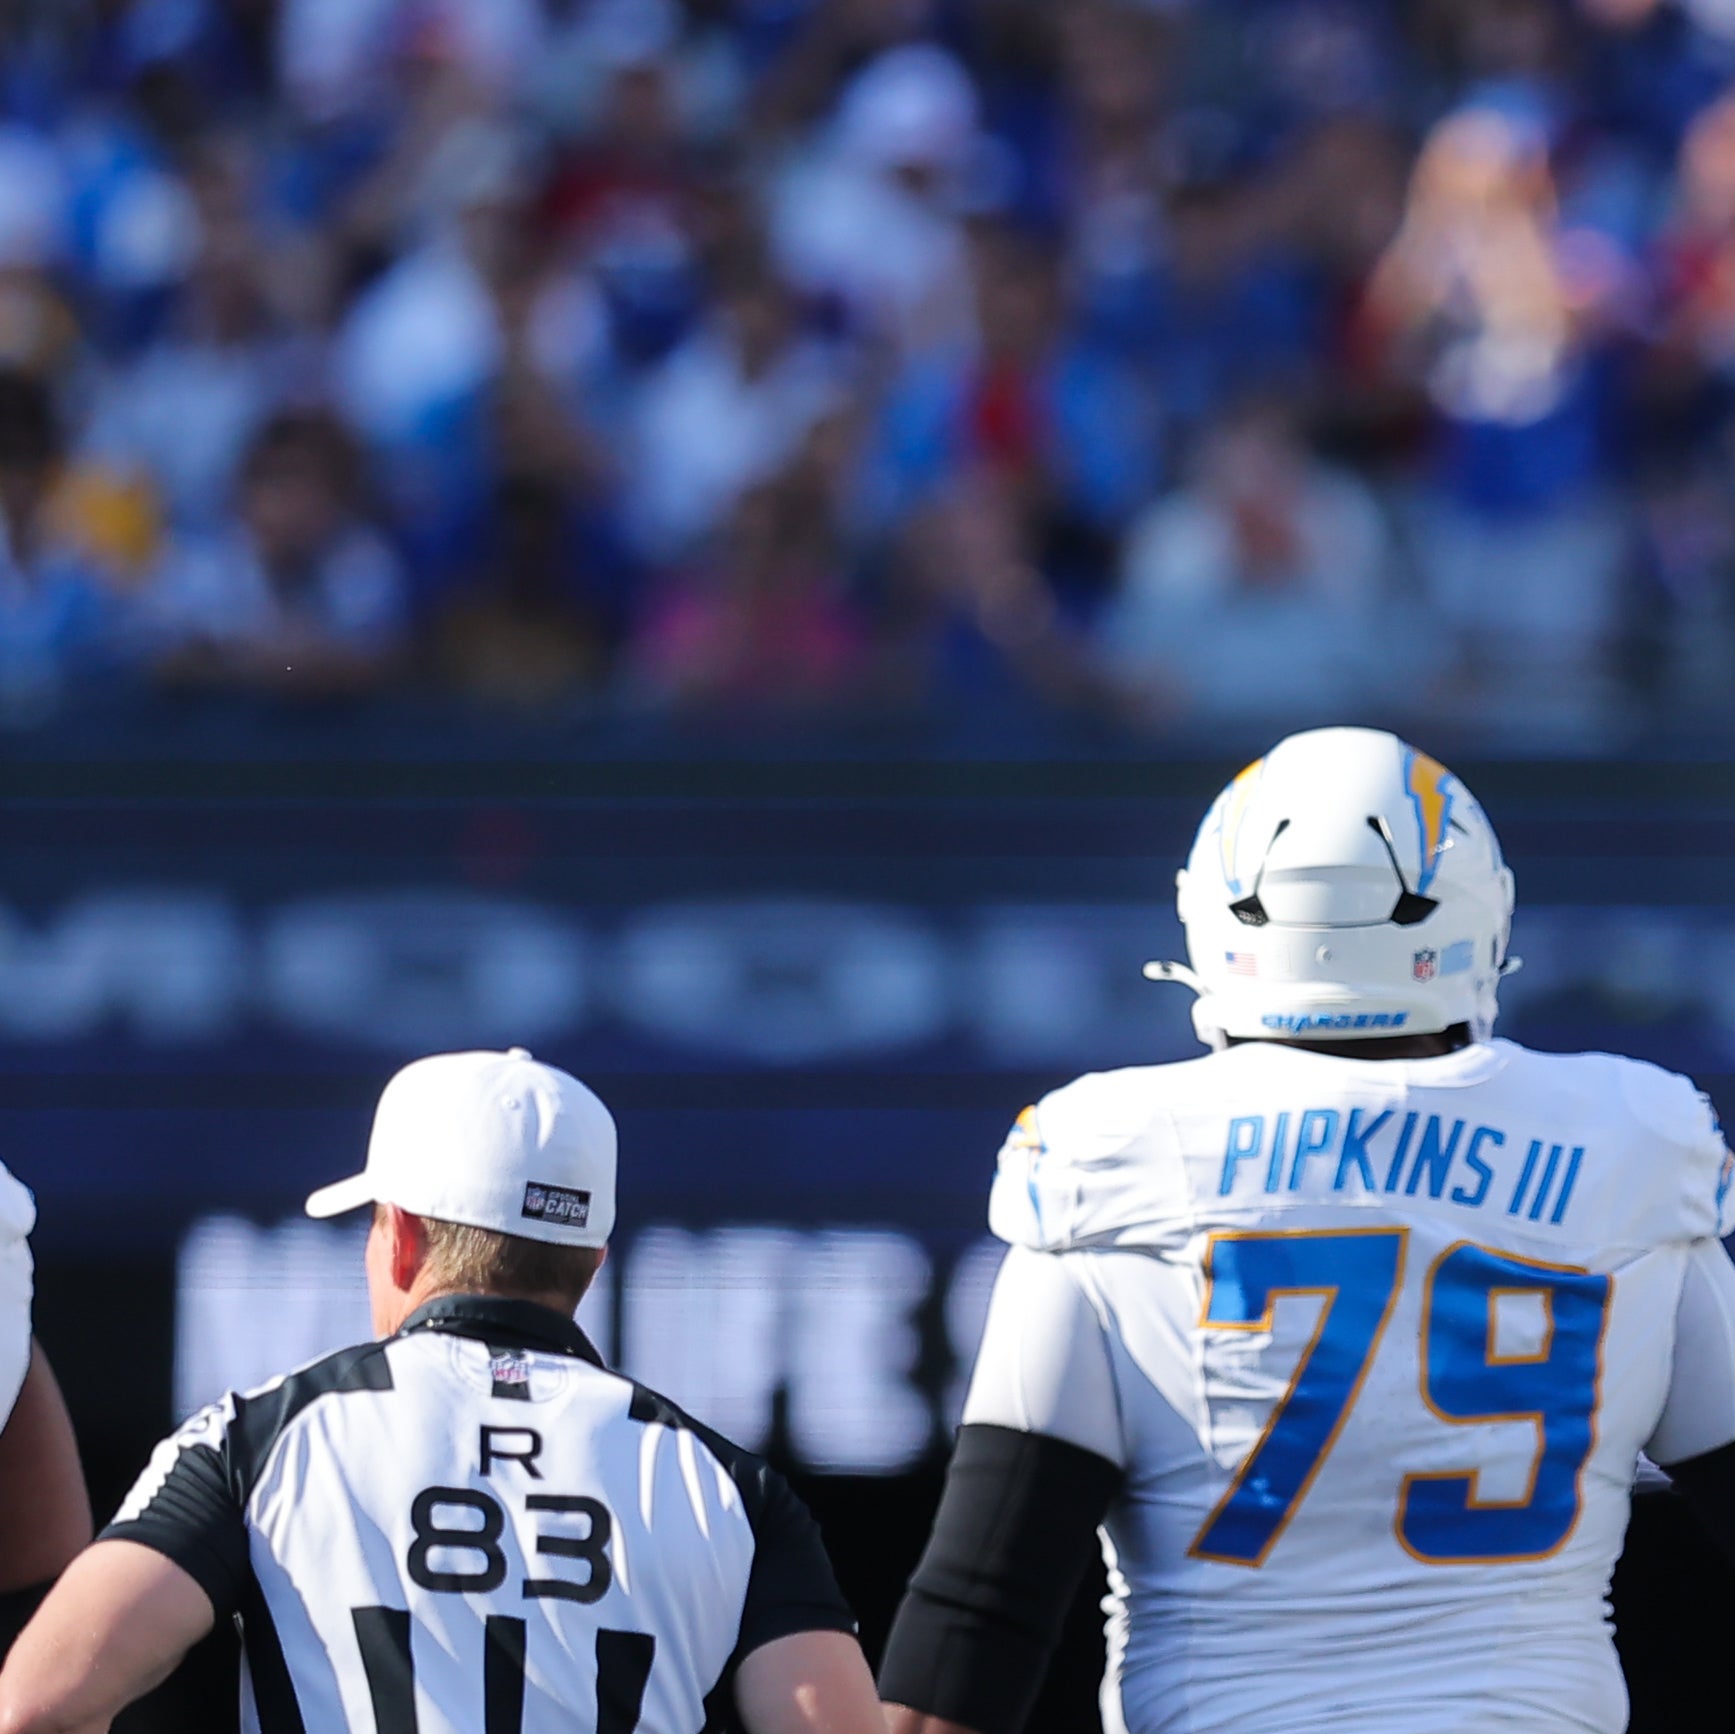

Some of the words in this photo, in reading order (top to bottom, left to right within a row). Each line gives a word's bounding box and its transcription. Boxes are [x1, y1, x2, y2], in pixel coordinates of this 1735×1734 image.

[545, 1199, 588, 1219] CATCH
[1218, 1107, 1505, 1208] PIPKINS
[1507, 1138, 1586, 1226] III
[479, 1424, 544, 1480] R
[1187, 1226, 1614, 1569] 79
[407, 1486, 612, 1605] 83
